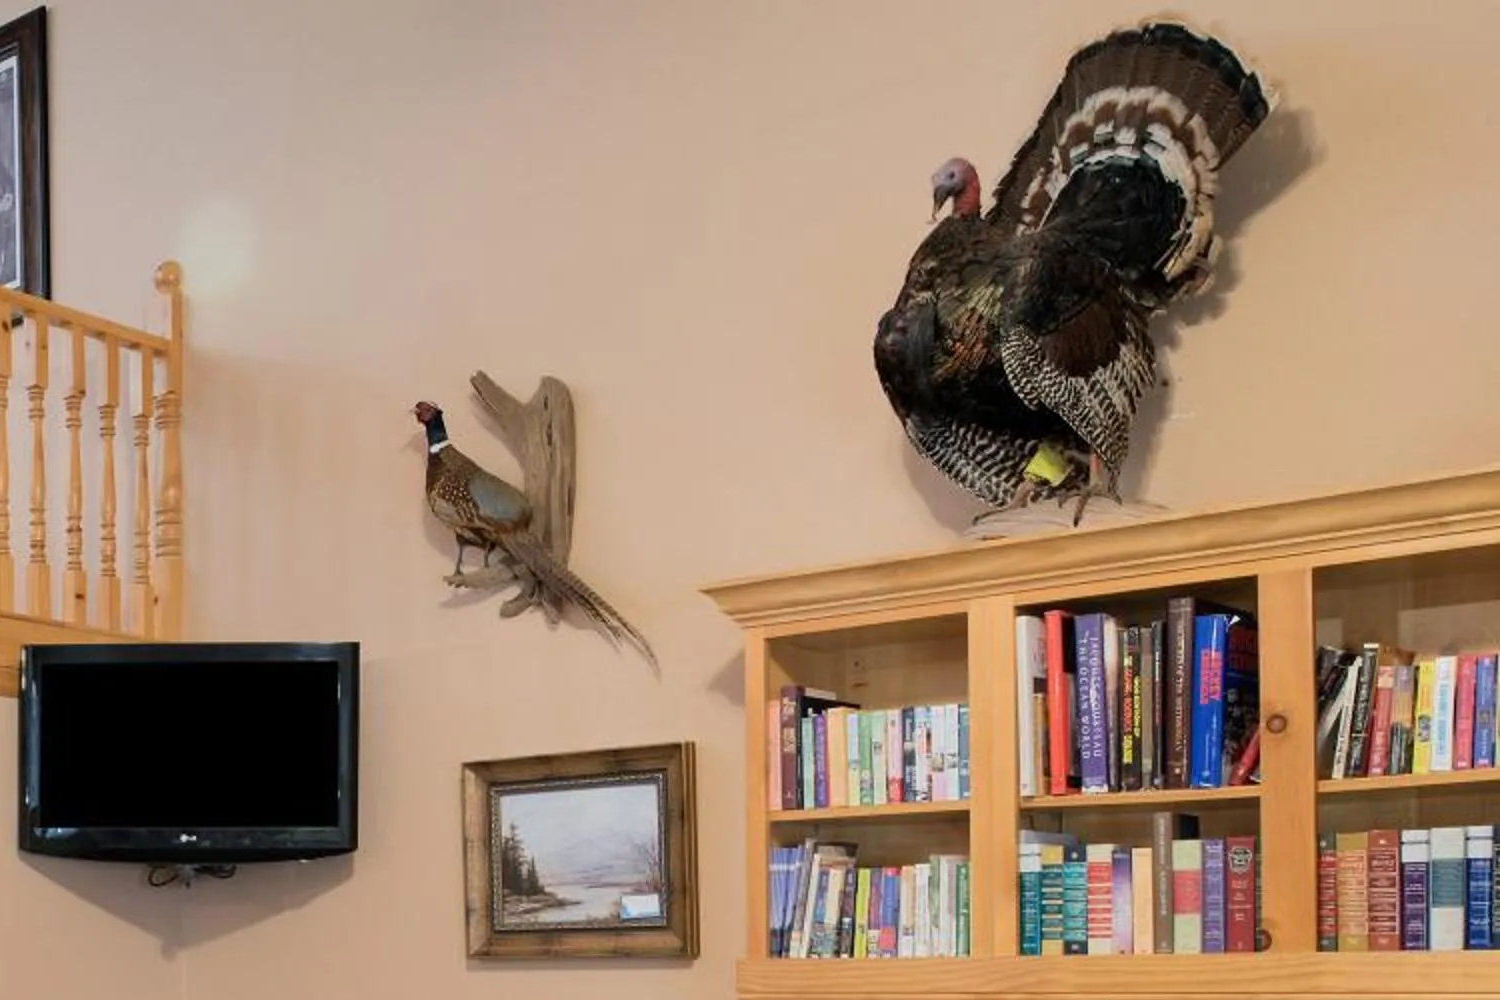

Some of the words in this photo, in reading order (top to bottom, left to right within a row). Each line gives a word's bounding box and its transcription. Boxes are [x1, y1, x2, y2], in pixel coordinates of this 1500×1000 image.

[1078, 638, 1089, 663] THE
[1079, 666, 1090, 710] OCEAN
[1081, 715, 1091, 759] WORLD
